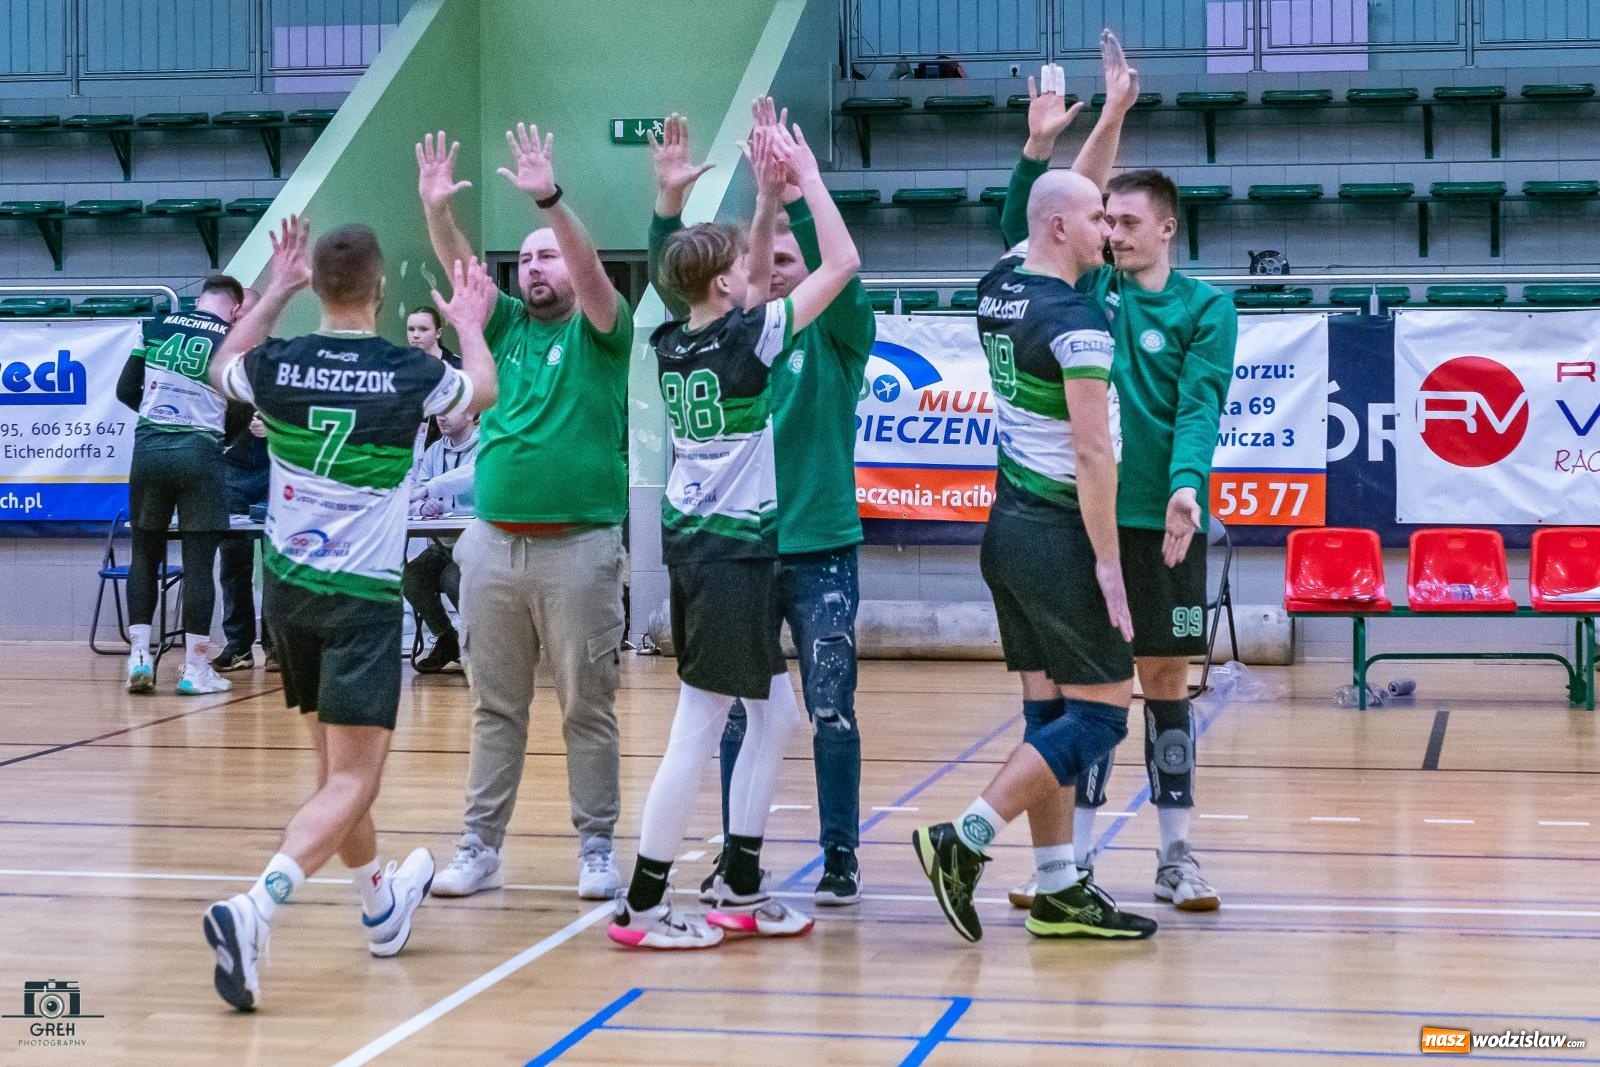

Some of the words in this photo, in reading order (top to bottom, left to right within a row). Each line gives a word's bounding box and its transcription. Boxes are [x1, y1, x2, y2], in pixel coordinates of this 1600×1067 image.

[163, 315, 228, 334] MARCHWIAK
[156, 332, 213, 377] 49
[983, 332, 1017, 400] 19
[0, 350, 86, 393] ech
[276, 362, 397, 393] BŁASZCZOK
[1235, 364, 1295, 379] orzu:
[661, 368, 725, 441] 98
[918, 390, 993, 413] MUL
[1249, 397, 1276, 415] 69
[31, 423, 60, 435] 606
[65, 423, 91, 436] 363
[96, 423, 126, 436] 647
[308, 406, 356, 477] 7
[1282, 429, 1295, 447] 3
[4, 444, 101, 459] Eichendorffa
[107, 445, 116, 458] 2
[856, 484, 996, 507] eczenia-racib
[1218, 483, 1258, 516] 55
[1268, 483, 1309, 516] 77
[1172, 606, 1203, 637] 99
